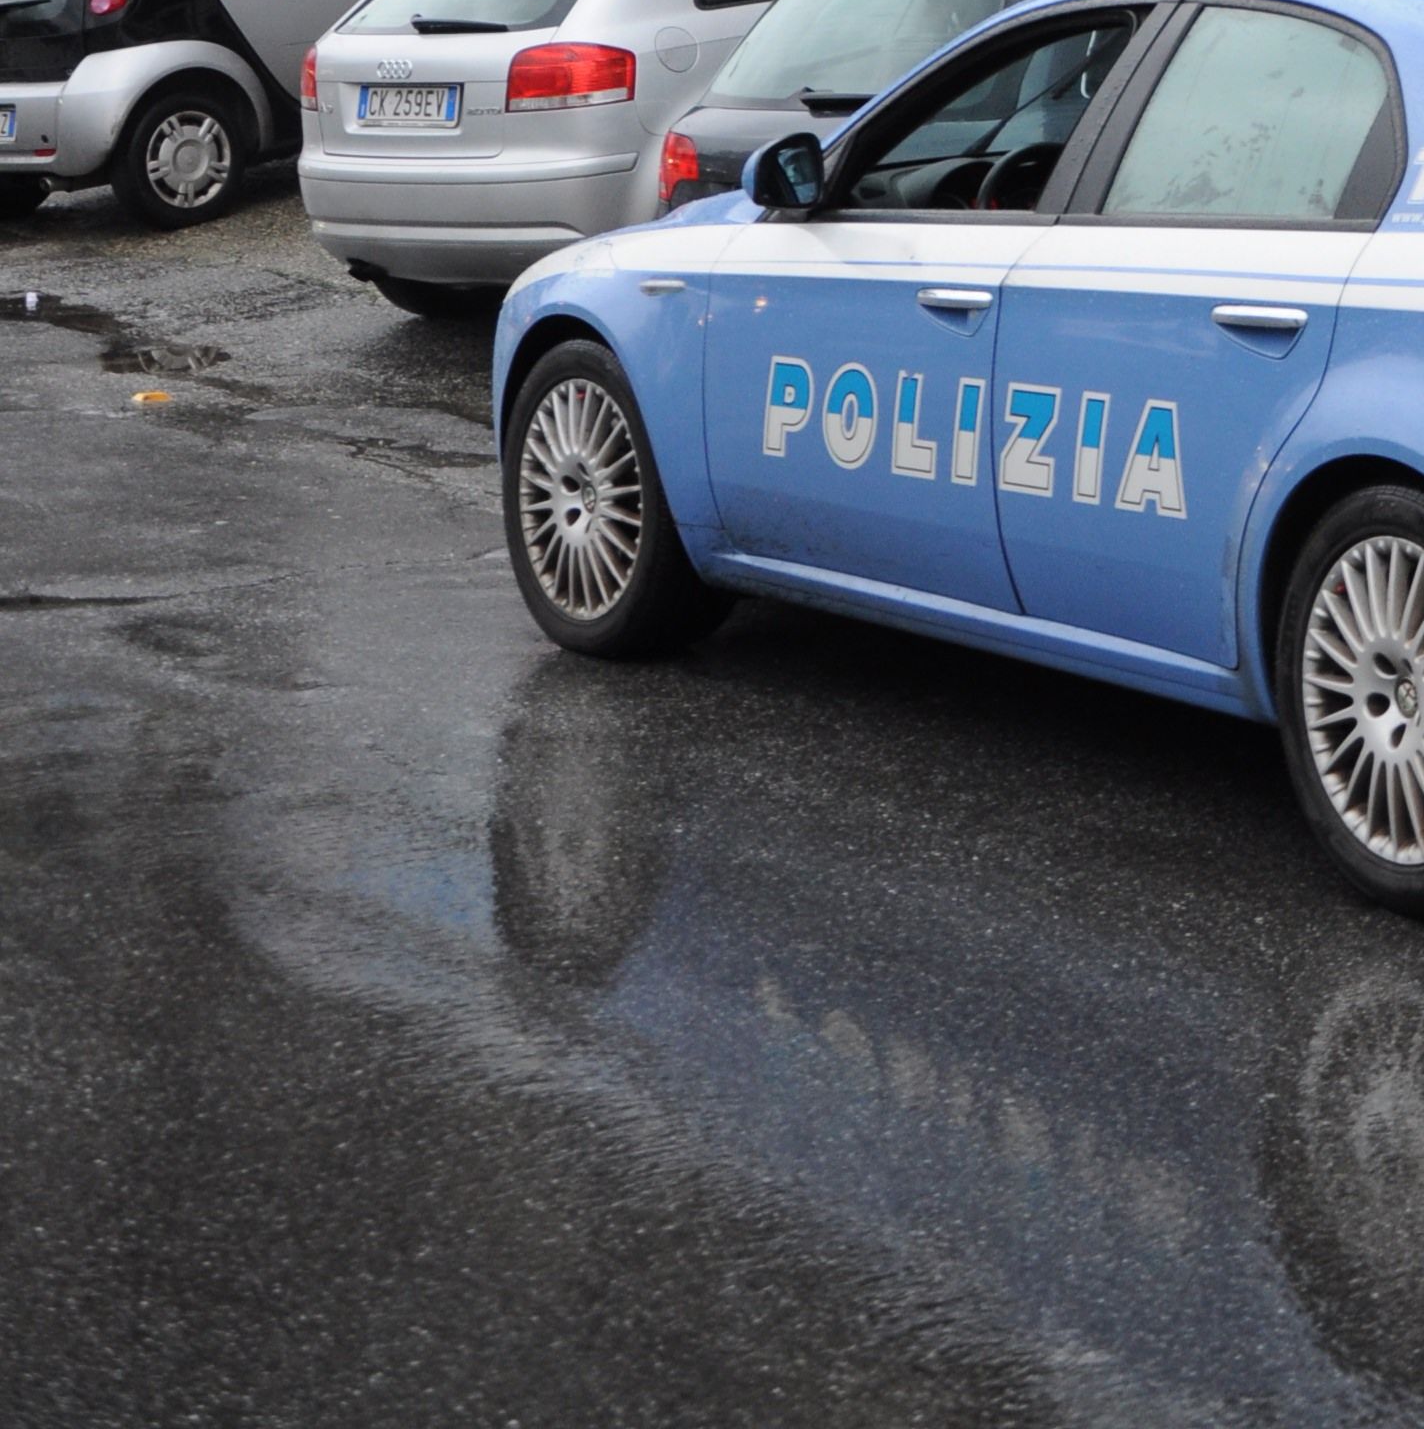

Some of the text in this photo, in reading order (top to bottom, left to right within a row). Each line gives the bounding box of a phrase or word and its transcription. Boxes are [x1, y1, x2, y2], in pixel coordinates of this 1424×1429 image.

[369, 89, 445, 118] CK 259EV
[762, 354, 1187, 520] POLIZIA
